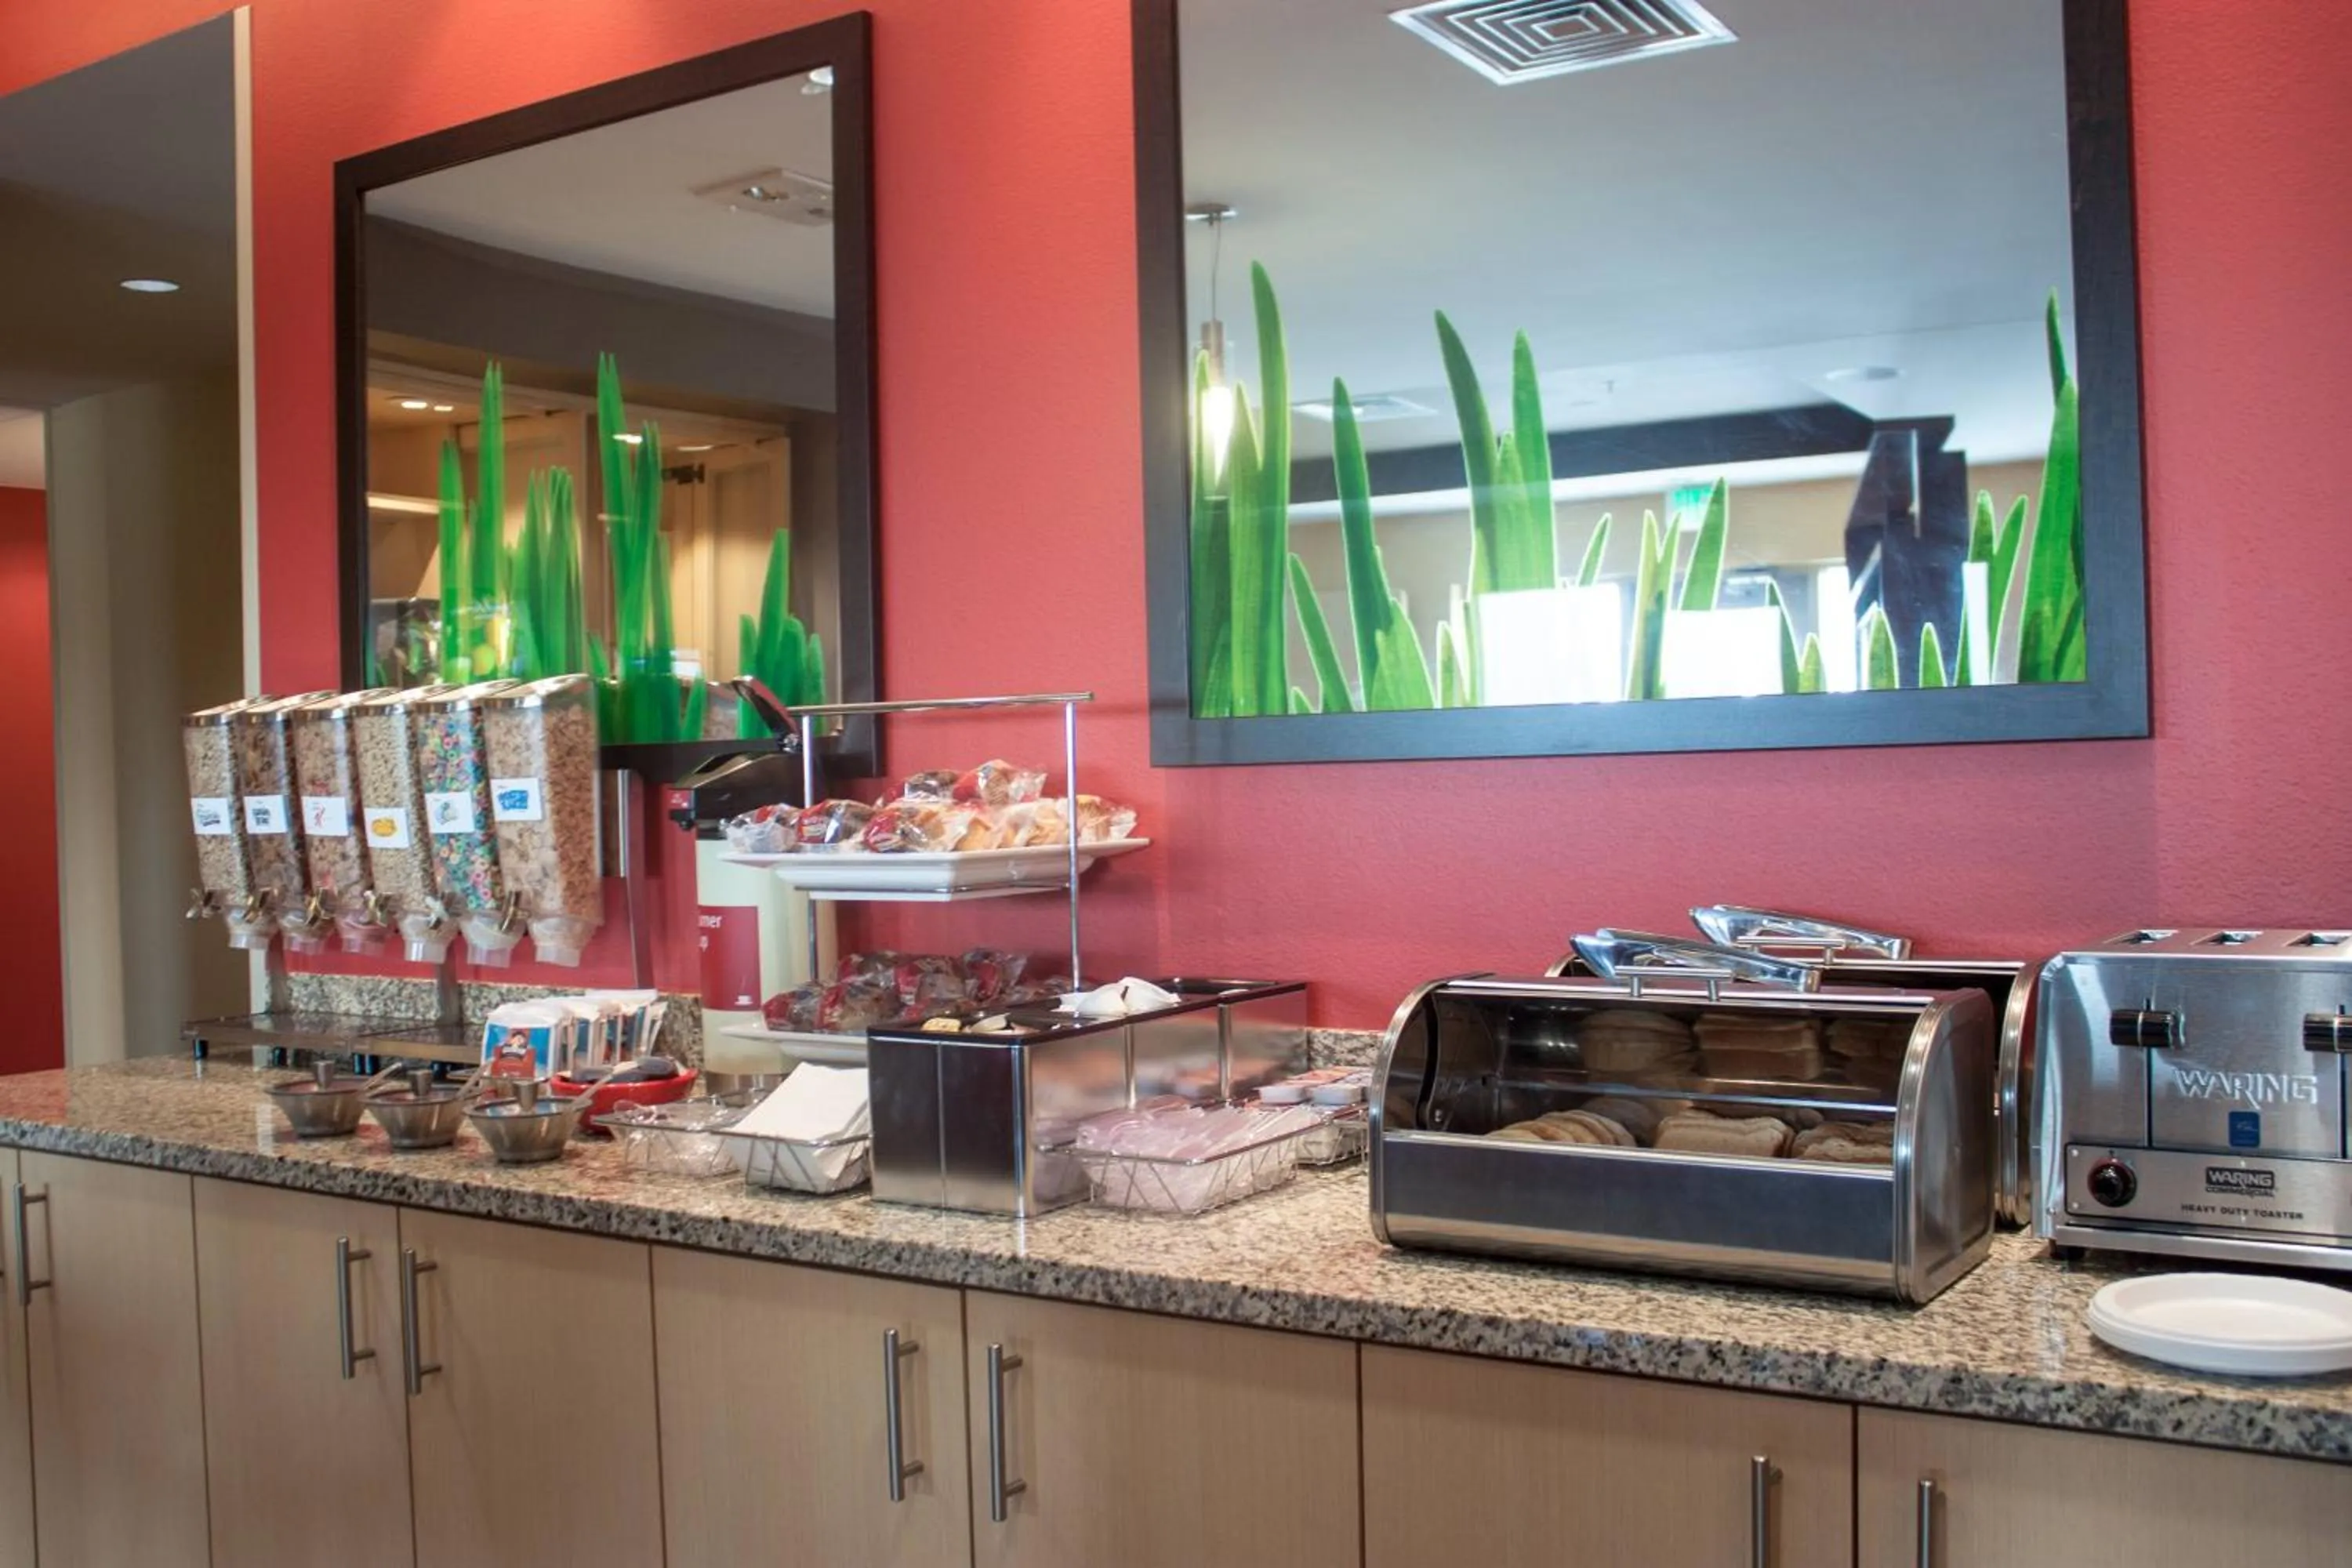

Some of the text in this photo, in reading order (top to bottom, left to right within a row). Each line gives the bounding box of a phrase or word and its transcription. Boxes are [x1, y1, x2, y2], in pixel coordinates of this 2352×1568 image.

[2174, 1070, 2318, 1110] WARING
[2209, 1170, 2273, 1189] WARING
[2181, 1203, 2303, 1220] HEAVY DUTY TOASTER
